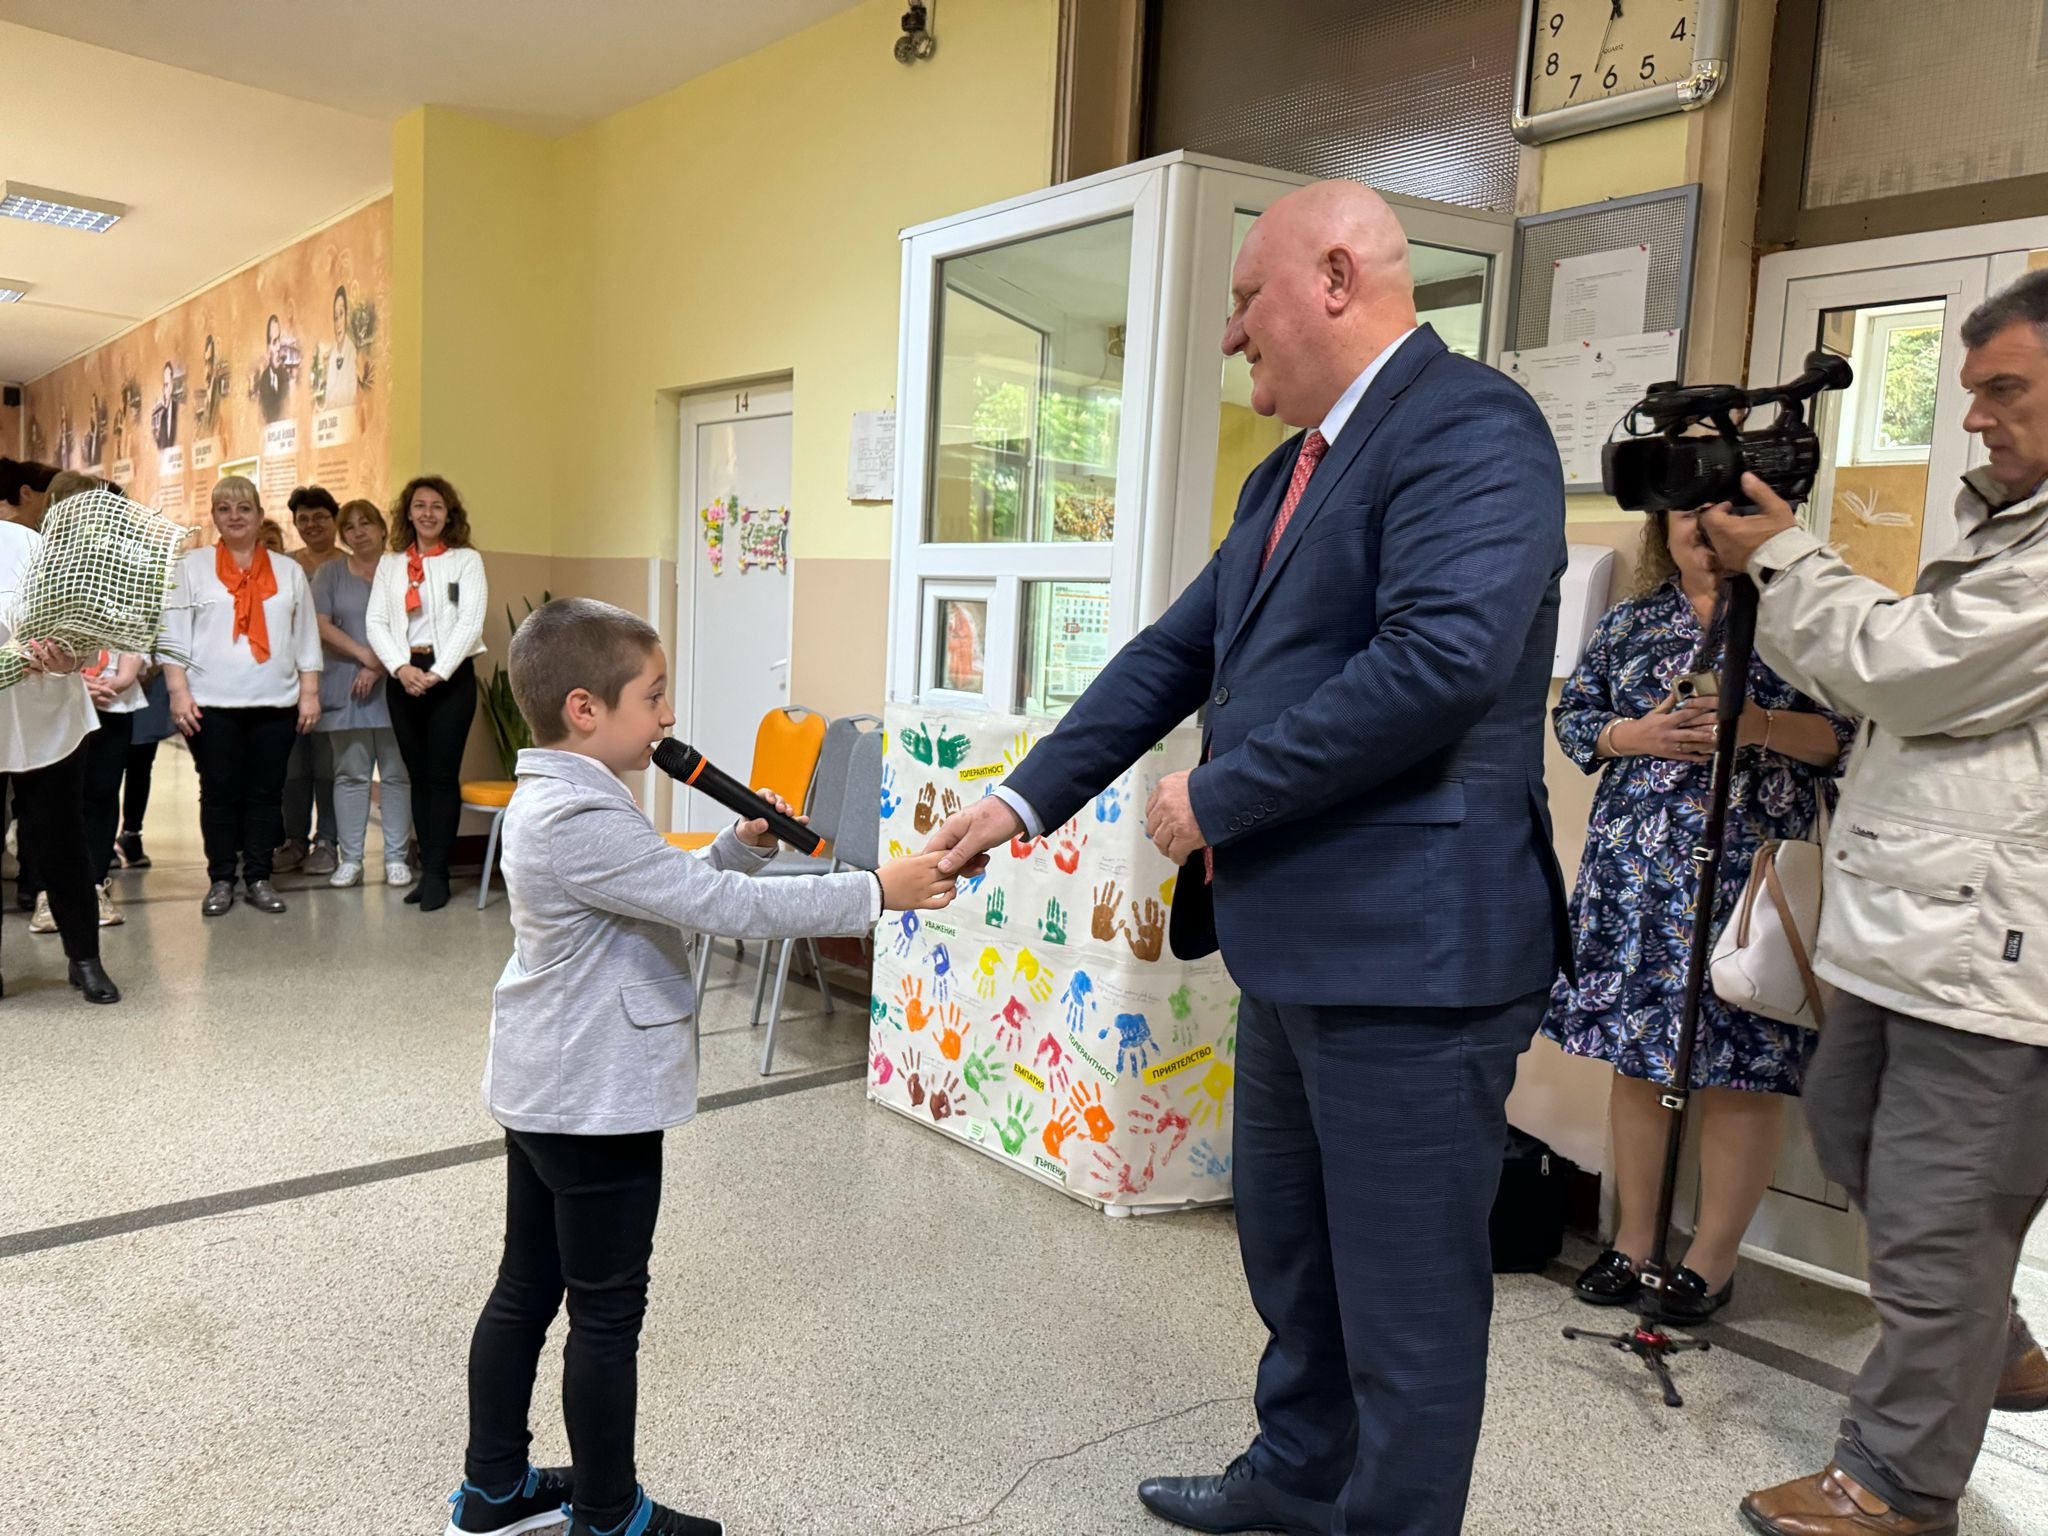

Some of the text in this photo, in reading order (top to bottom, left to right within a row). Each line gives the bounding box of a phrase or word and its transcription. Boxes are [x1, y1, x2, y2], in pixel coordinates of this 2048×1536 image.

[1550, 14, 1564, 38] 9
[1670, 16, 1686, 41] 4
[1546, 53, 1559, 76] 8
[1602, 65, 1618, 89] 6
[1639, 54, 1655, 80] 5
[1569, 74, 1582, 99] 7
[736, 392, 748, 413] 14
[1069, 1032, 1116, 1083] ТОЛЕРАНТНОСТ
[1152, 1046, 1212, 1079] ПРИЯТЕЛСТВО
[1014, 1063, 1045, 1092] ЕМПАТИЯ
